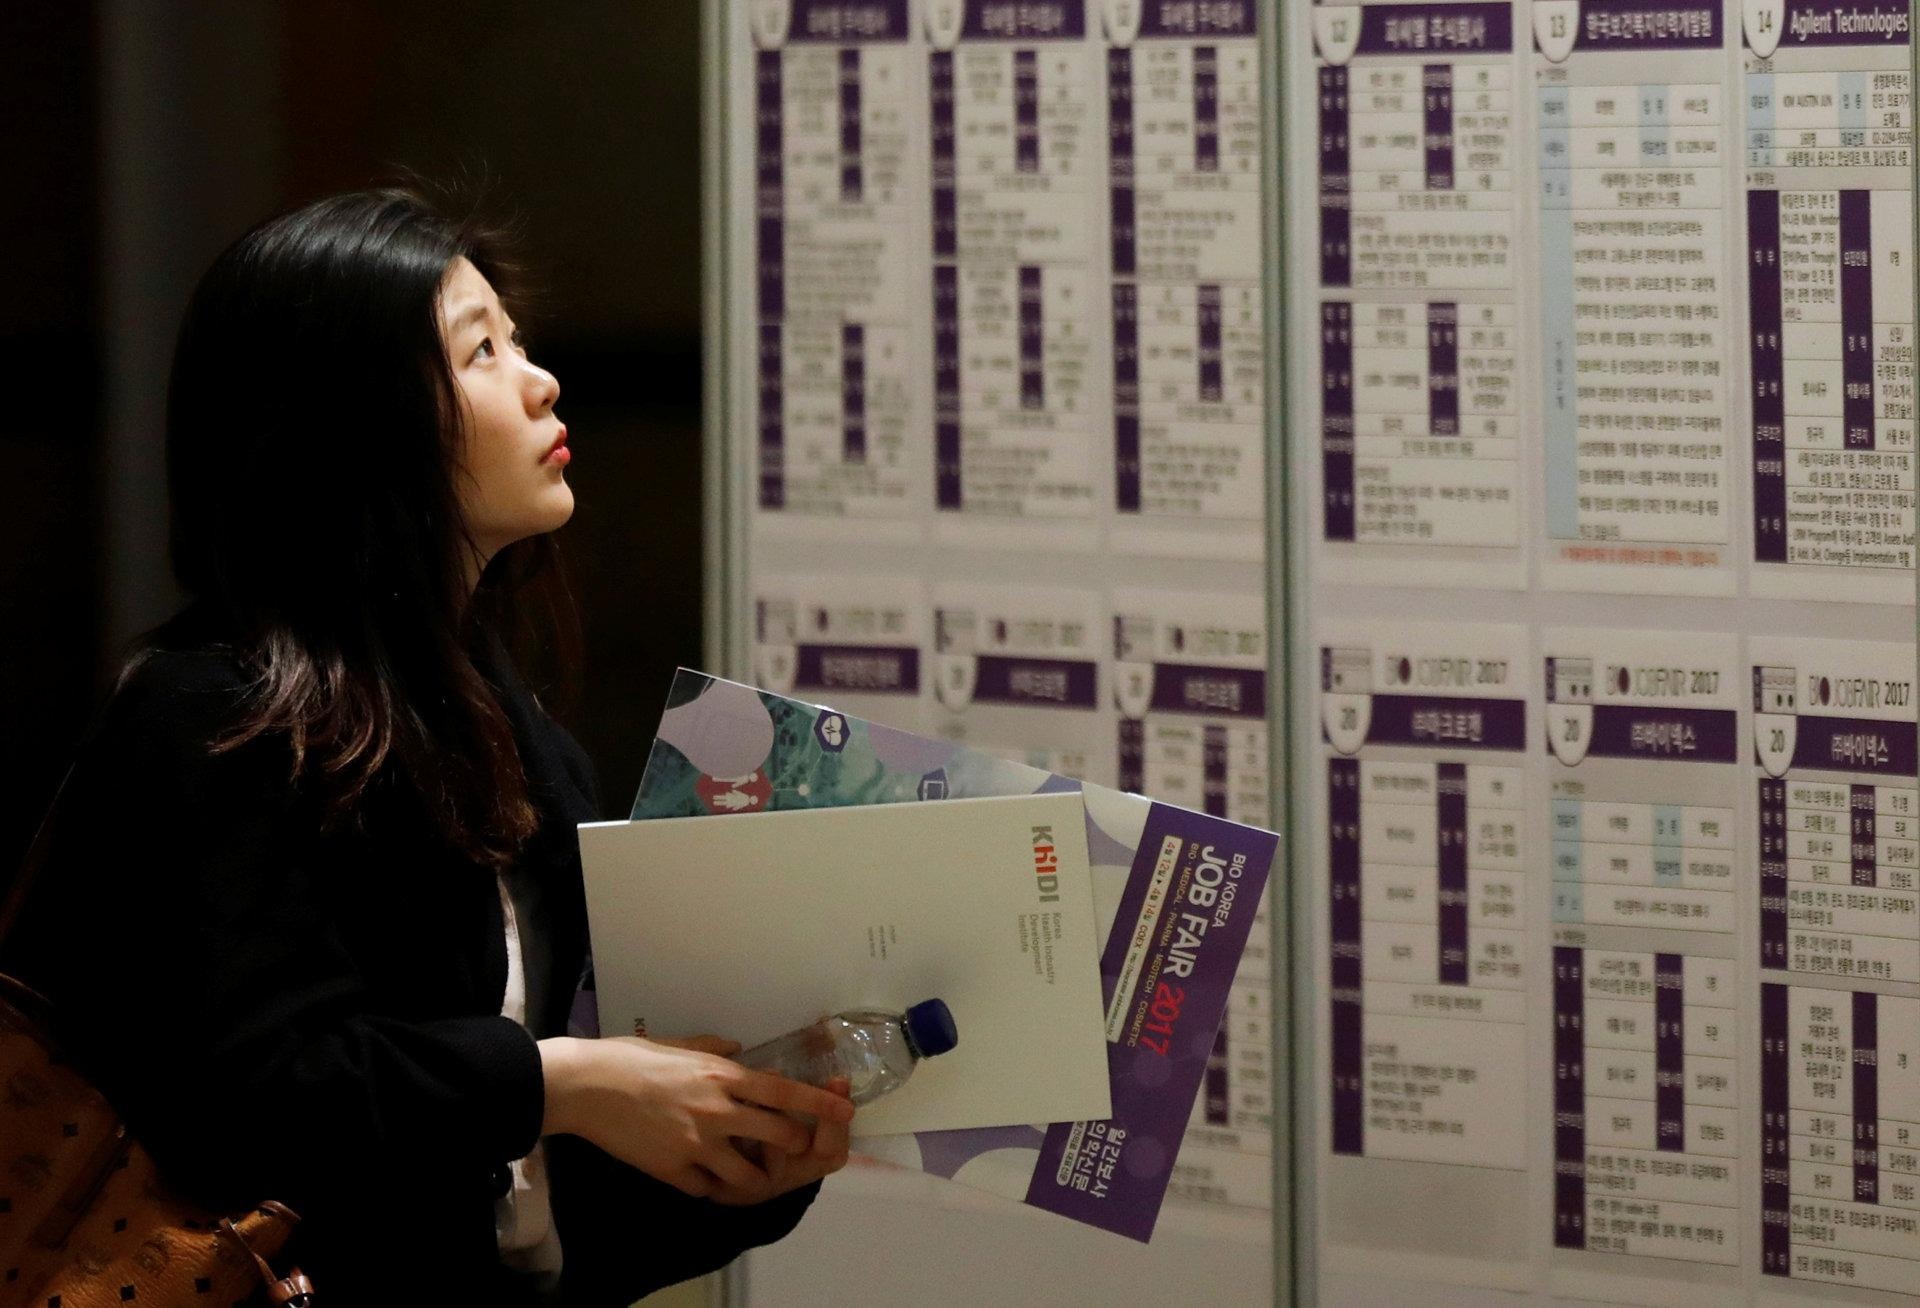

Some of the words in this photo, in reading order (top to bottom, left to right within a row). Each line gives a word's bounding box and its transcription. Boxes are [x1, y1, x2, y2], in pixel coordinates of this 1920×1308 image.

[1758, 11, 1772, 33] 14
[1791, 9, 1831, 41] Agilent
[1835, 7, 1908, 39] Technologies
[1884, 681, 1911, 706] 2017
[1771, 729, 1786, 753] 20
[1031, 825, 1060, 904] KHIDI
[1188, 843, 1199, 860] BIO
[1228, 852, 1246, 879] BIO
[1171, 866, 1192, 905] MEDICAL
[1187, 845, 1228, 908] JOB
[1212, 882, 1240, 928] KOREA
[1018, 914, 1029, 953] Institute
[1029, 914, 1044, 976] Development
[1041, 912, 1053, 944] Health
[1052, 912, 1062, 940] Korea
[1133, 924, 1149, 949] COEX
[1158, 911, 1179, 948] PHARMA
[1163, 911, 1209, 979] FAIR
[1043, 945, 1056, 985] Industry
[1127, 1000, 1147, 1048] COSMETIC
[1141, 982, 1185, 1057] 2017
[1069, 1120, 1107, 1192] 의학신문
[1090, 1127, 1126, 1199] 일간보사
